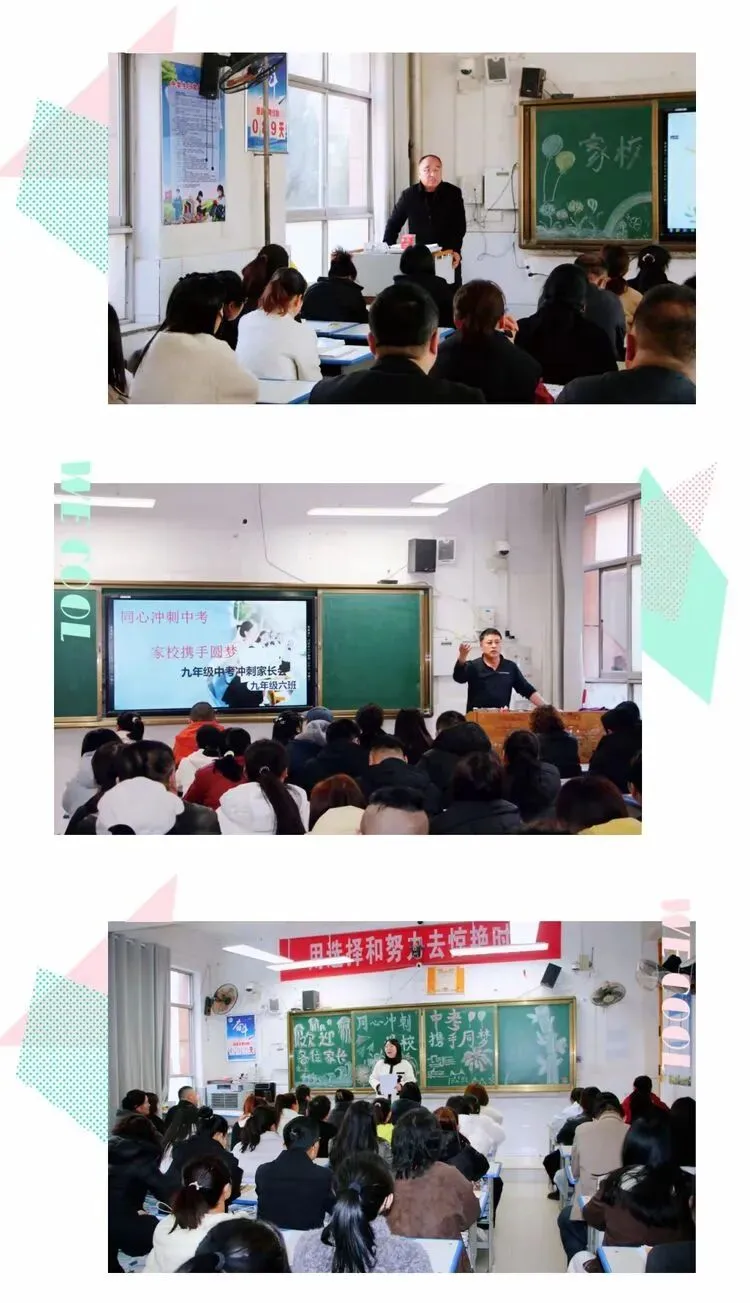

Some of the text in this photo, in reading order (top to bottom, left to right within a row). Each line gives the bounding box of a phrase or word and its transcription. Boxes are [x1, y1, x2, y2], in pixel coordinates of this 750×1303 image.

[121, 610, 208, 625] 同心冲刺中考
[152, 645, 238, 659] 家校携手圆梦
[181, 665, 288, 678] 九年级中考冲刺家长会
[250, 681, 297, 691] 九年级六班
[430, 1009, 462, 1034] 中考
